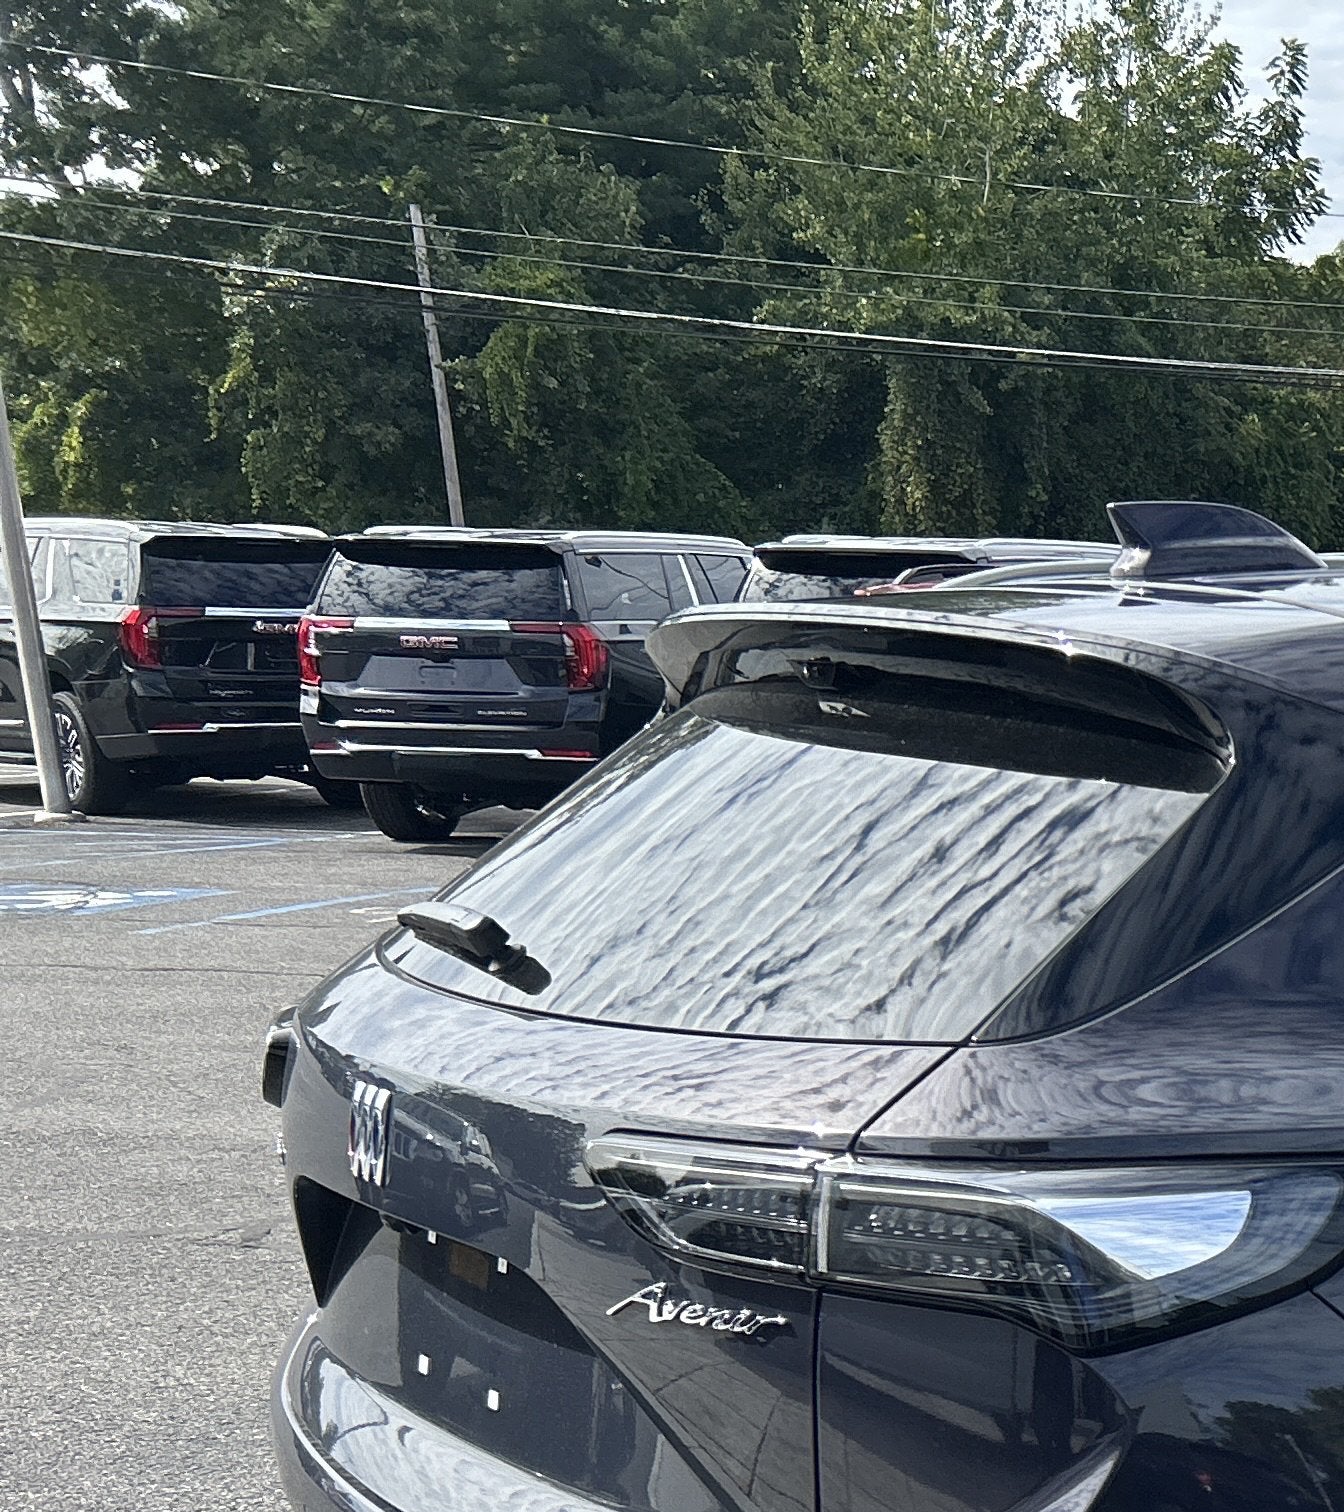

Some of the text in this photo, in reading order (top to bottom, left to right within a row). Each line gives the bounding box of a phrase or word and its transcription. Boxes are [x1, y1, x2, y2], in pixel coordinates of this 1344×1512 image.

[252, 620, 298, 634] GM
[399, 635, 460, 650] GMC
[605, 1280, 792, 1336] Avenir
